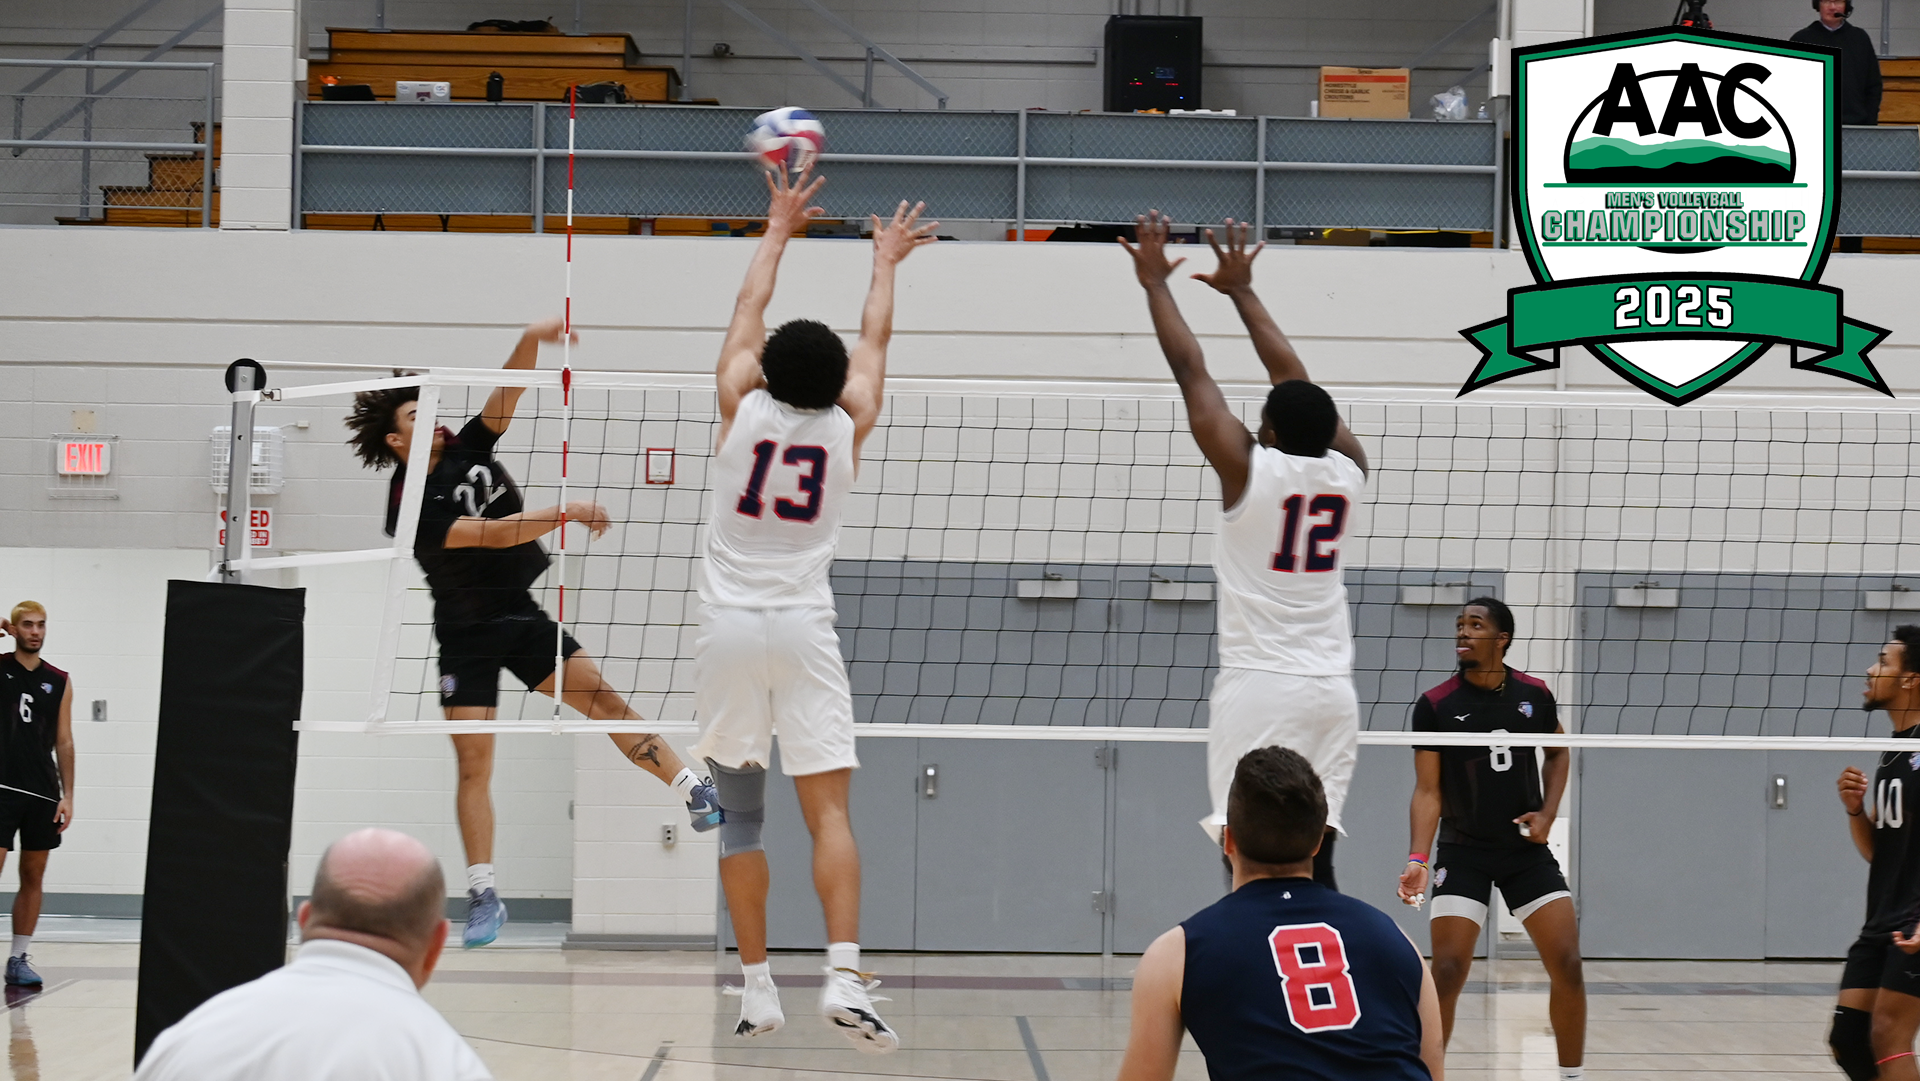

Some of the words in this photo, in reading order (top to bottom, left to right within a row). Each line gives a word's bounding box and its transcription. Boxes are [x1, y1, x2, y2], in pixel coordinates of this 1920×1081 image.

[65, 443, 104, 473] EXIT
[735, 439, 829, 525] 13
[453, 463, 508, 518] 22
[250, 510, 270, 528] ED
[1268, 493, 1351, 574] 12
[19, 692, 34, 723] 6
[1489, 728, 1513, 772] 8
[1875, 777, 1904, 830] 10
[1268, 922, 1362, 1034] 8
